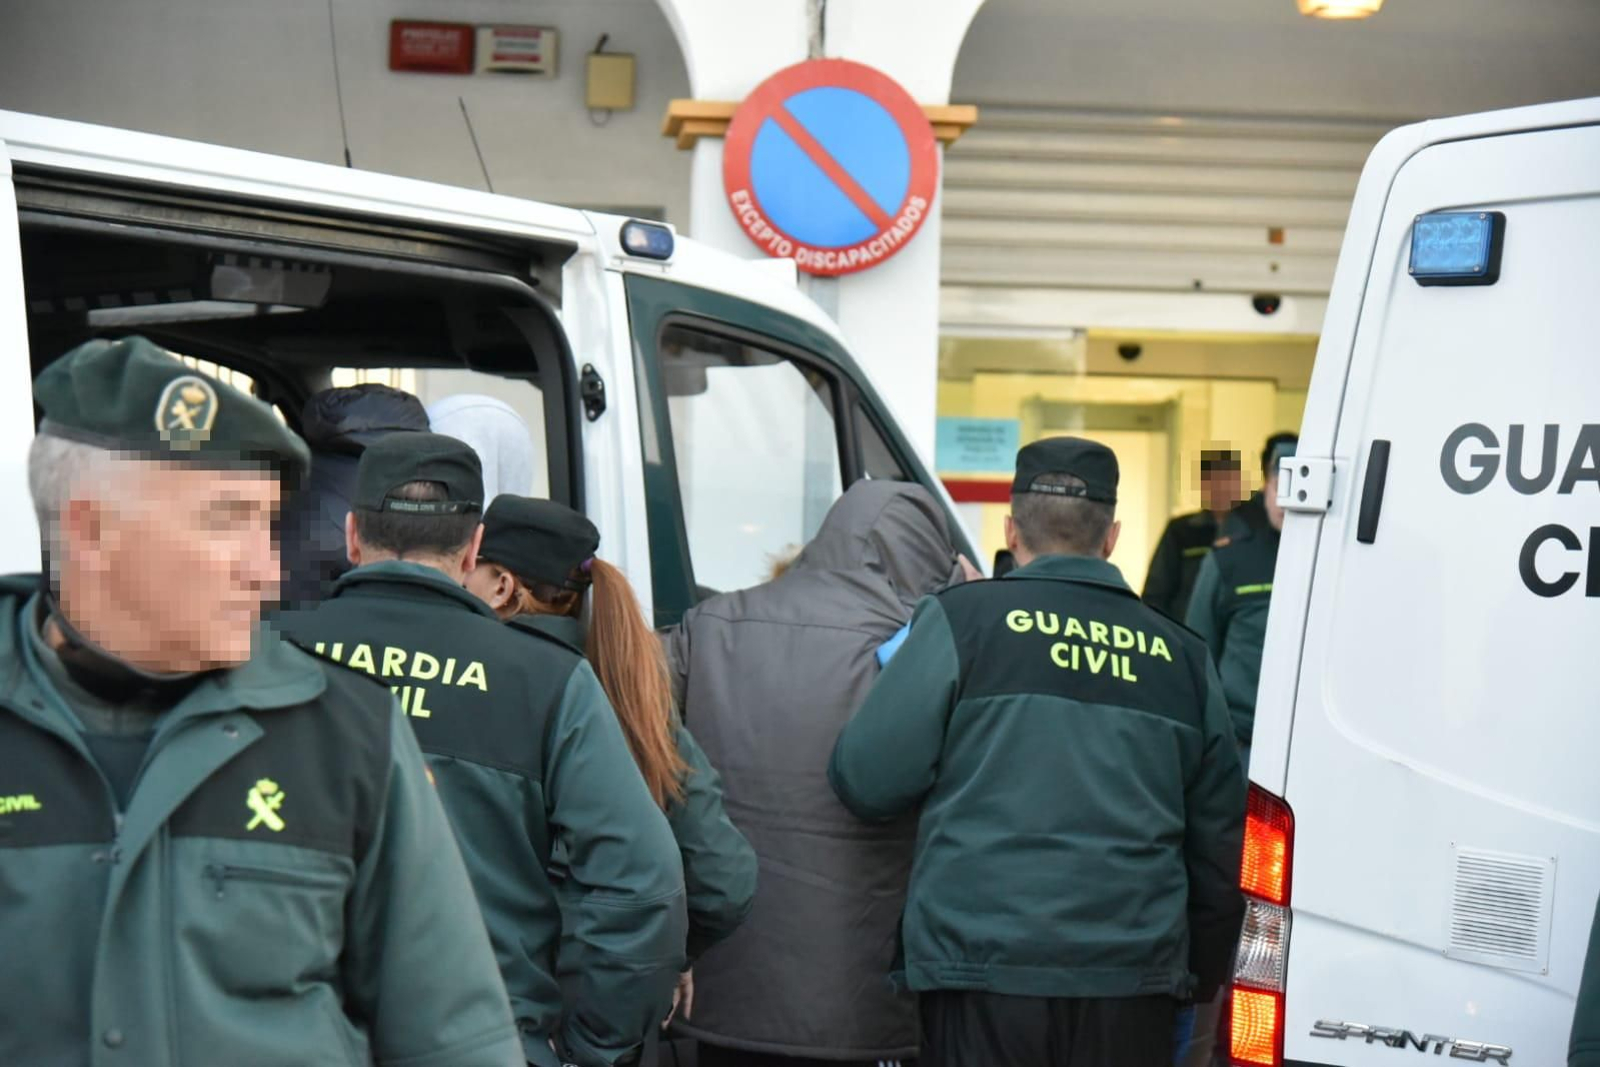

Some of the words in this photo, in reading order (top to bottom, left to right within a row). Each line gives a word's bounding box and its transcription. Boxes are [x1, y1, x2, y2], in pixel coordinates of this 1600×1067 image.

[731, 189, 792, 257] EXCEPTO
[795, 195, 927, 270] DISCAPACITADOS
[1440, 422, 1600, 495] GUA
[1006, 609, 1173, 662] GUARDIA
[1050, 642, 1138, 682] CIVIL
[390, 685, 431, 718] IL
[1309, 1019, 1513, 1066] SPRINTER
